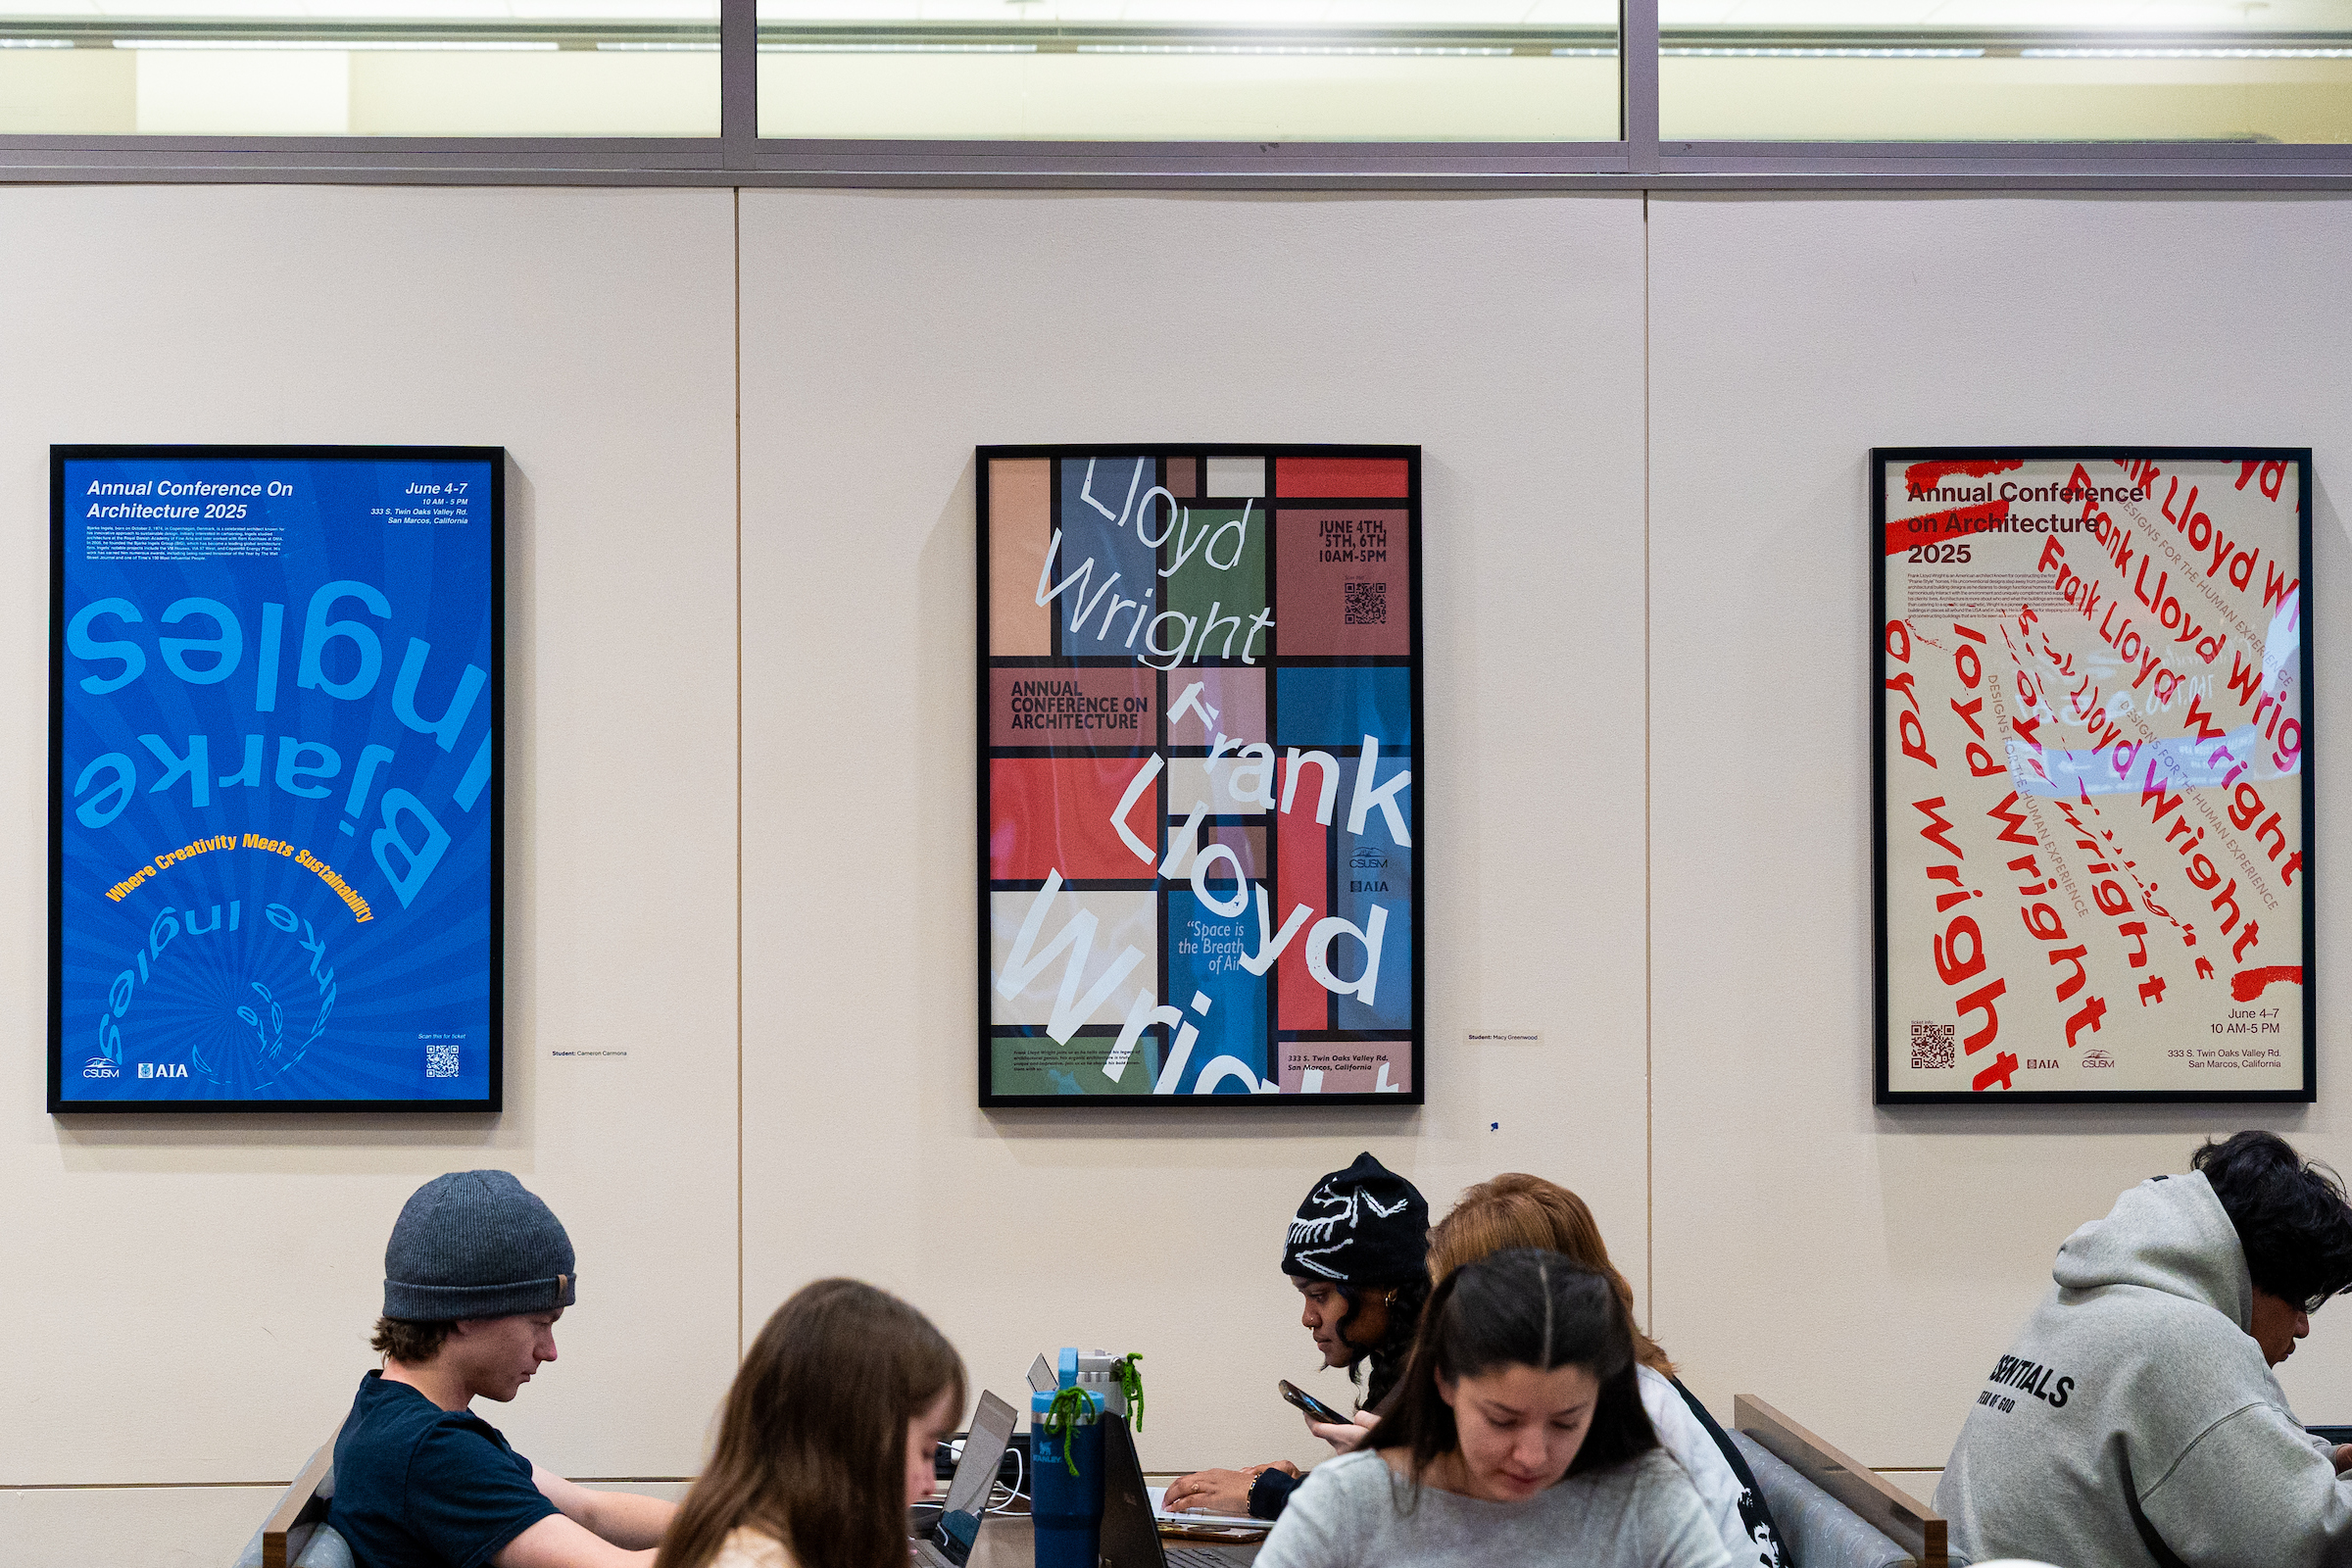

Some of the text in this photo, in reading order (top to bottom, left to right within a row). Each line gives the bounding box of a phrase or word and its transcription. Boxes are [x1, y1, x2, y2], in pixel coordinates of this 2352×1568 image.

[86, 480, 293, 497] Annual Conference On
[405, 482, 468, 495] June 4-7
[1907, 481, 2144, 503] Annual Conference
[86, 503, 248, 519] Architecture 2025
[1080, 457, 1253, 577] Lloyd
[403, 516, 432, 525] Marcos,
[1319, 520, 1387, 537] JUNE 4TH,
[1907, 513, 2099, 533] on Architecture
[1325, 534, 1387, 550] 5TH, 6TH
[2161, 475, 2260, 593] Lloyd
[1319, 550, 1387, 563] 10AM-5PM
[1907, 544, 1972, 564] 2025
[1035, 527, 1276, 671] Wright
[2118, 494, 2160, 543] DESIGNS
[2158, 539, 2181, 568] FOR
[2180, 561, 2200, 584] THE
[2196, 579, 2240, 623] HUMAN
[2234, 620, 2293, 687] EXPERIENCE
[2064, 463, 2133, 578] Frank
[2133, 555, 2227, 664] Lloyd
[2227, 650, 2302, 771] Wrig
[1011, 680, 1082, 698] ANNUAL
[1011, 697, 1149, 713] CONFERENCE ON
[1010, 713, 1139, 730] ARCHITECTURE
[2099, 601, 2186, 705] Lloyd
[2183, 694, 2302, 887] Wright
[1166, 681, 1412, 848] Frank
[1987, 674, 2089, 918] DESIGNS FOR THE HUMAN EXPERIENCE
[2120, 701, 2161, 750] DESIGNS
[2158, 749, 2180, 776] FOR
[2177, 772, 2196, 795] THE
[2192, 793, 2230, 840] HUMAN
[2227, 839, 2278, 911] EXPERIENCE
[73, 733, 452, 910] Bjarke
[2070, 674, 2143, 780] Lloyd
[2140, 759, 2260, 964] Wright
[1348, 858, 1388, 868] CSUSM
[105, 833, 374, 924] Where Creativity Meets Sustainability
[1109, 752, 1389, 1005] Lloyd
[1364, 881, 1389, 892] AIA
[2054, 801, 2167, 1007] Wright
[1986, 790, 2107, 1049] Wright
[1235, 921, 1245, 937] is
[1178, 939, 1245, 955] the Breath
[1911, 796, 2019, 1092] Wright
[1208, 956, 1222, 975] of
[996, 867, 1399, 1094] Wri
[2228, 1007, 2256, 1018] June
[2211, 1023, 2280, 1034] 10 AM-5 PM
[1352, 1054, 1374, 1063] Valley
[2167, 1049, 2281, 1058] 333 S. Twin Oaks Valley Rd.
[155, 1063, 188, 1078] AIA
[2038, 1060, 2059, 1069] AIA
[2207, 1060, 2240, 1069] Marcos,
[2241, 1059, 2281, 1068] California
[82, 1069, 120, 1078] CSUSM
[1997, 1396, 2016, 1414] GOD
